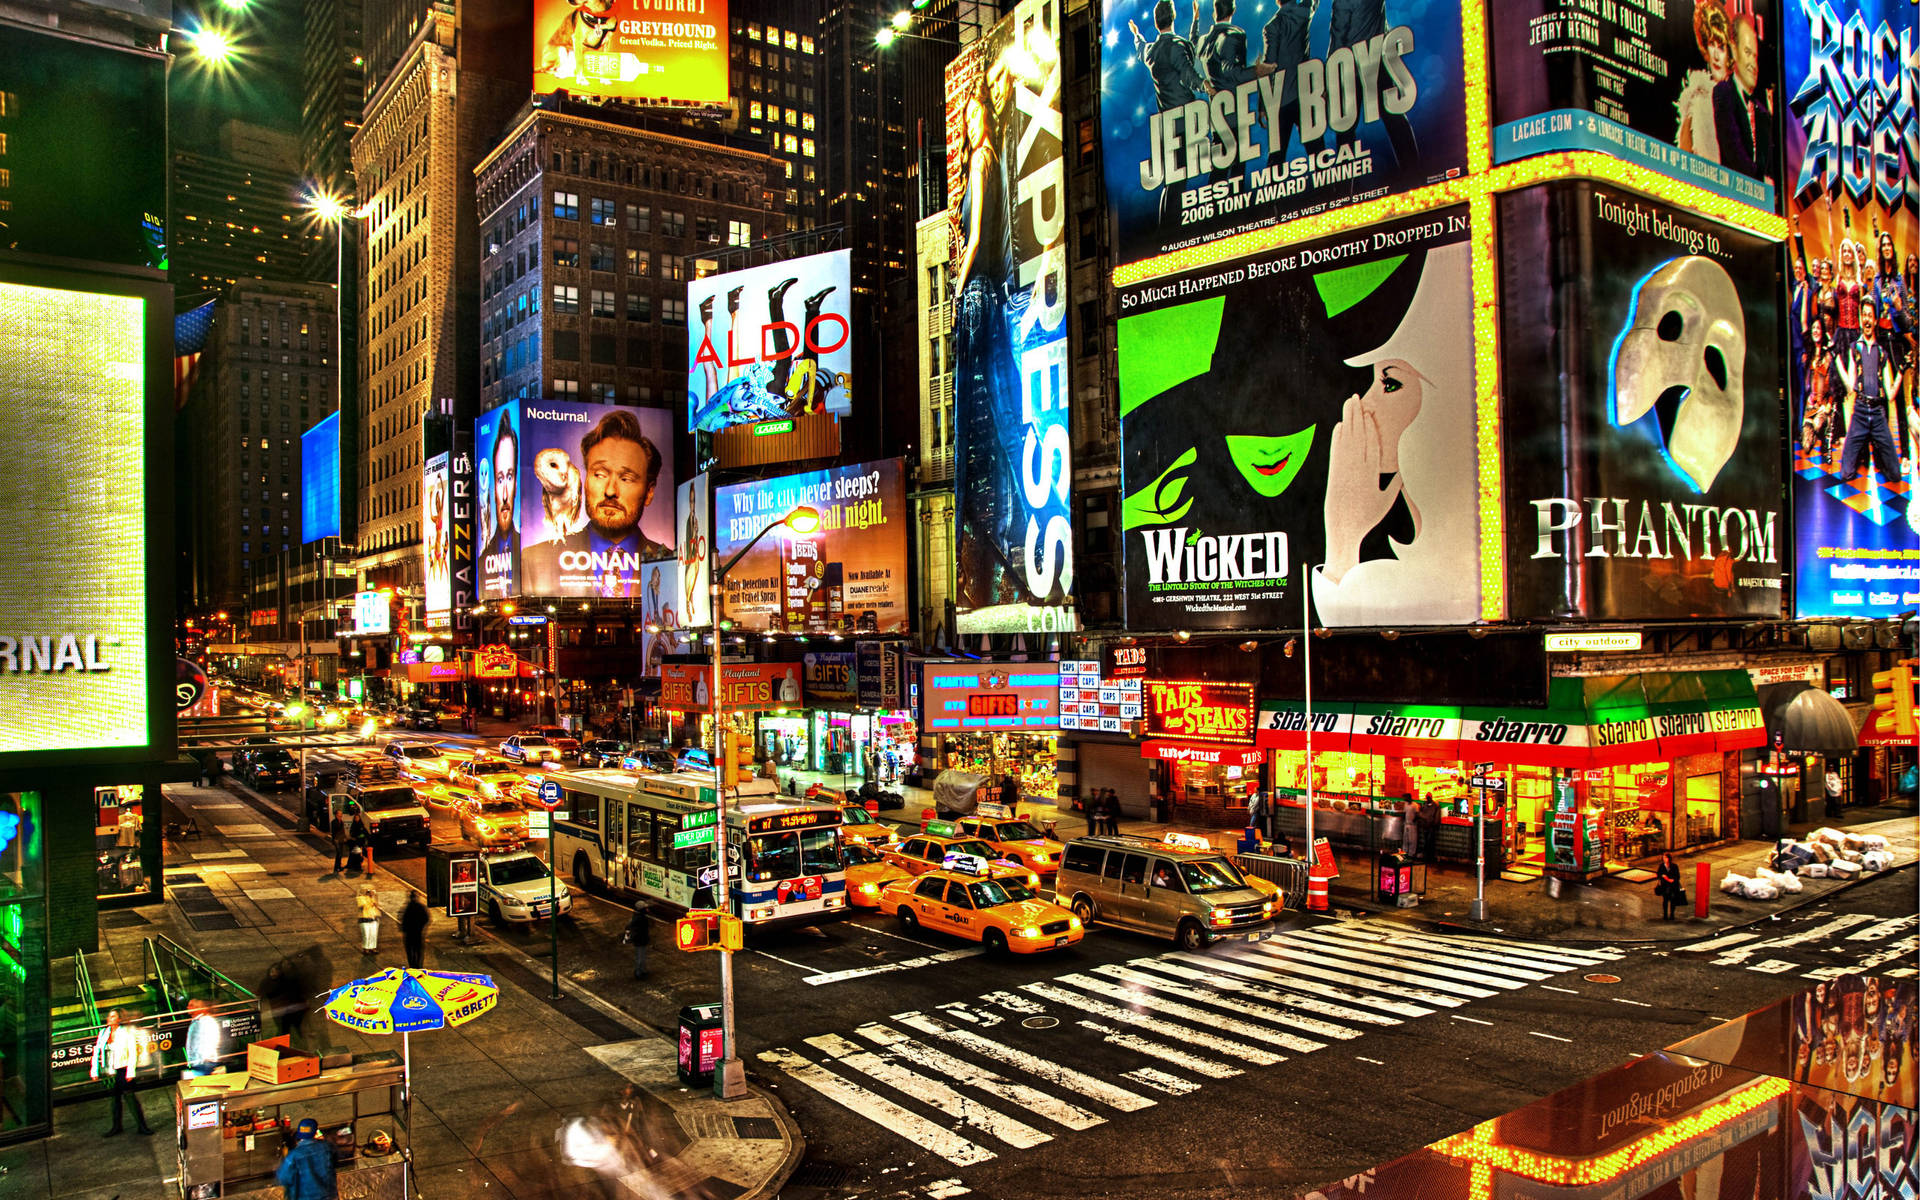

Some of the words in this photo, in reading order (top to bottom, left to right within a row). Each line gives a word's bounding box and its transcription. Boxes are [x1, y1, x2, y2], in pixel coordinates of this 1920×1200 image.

[1529, 12, 1558, 27] MUSIC
[1568, 11, 1591, 24] LYRICS
[1620, 6, 1647, 37] FOLLES
[619, 20, 717, 39] GREYHOUND
[1529, 21, 1562, 46] JERRY
[1568, 21, 1600, 46] HERMAN
[619, 36, 640, 45] Great
[640, 37, 666, 47] Vodka.
[668, 40, 692, 49] Priced
[694, 41, 718, 50] Right.
[1614, 37, 1638, 63] HARVEY
[1638, 48, 1668, 77] FIERSTEIN
[1140, 69, 1286, 191] JERSEY
[1297, 25, 1418, 144] BOYS
[1512, 113, 1573, 143] LACAGE.COM
[1181, 175, 1243, 209] BEST
[1251, 139, 1371, 185] MUSICAL
[1181, 199, 1214, 225] 2006
[1218, 192, 1251, 217] TONY
[1312, 157, 1373, 189] WINNER
[1168, 236, 1201, 252] AUGUST
[1202, 227, 1235, 242] WILSON
[1237, 216, 1279, 233] THEATRE,
[1280, 211, 1299, 222] 245
[1300, 203, 1326, 217] WEST
[1352, 186, 1390, 203] STREET
[1594, 192, 1650, 236] Tonight
[1653, 209, 1704, 254] belongs
[1706, 232, 1733, 259] to...
[1140, 285, 1177, 305] MUCH
[1179, 269, 1245, 296] HAPPENED
[1247, 256, 1297, 280] BEFORE
[1300, 238, 1369, 267] DOROTHY
[1373, 222, 1443, 250] DROPPED
[689, 313, 849, 373] ALDO
[527, 407, 591, 423] Nocturnal.
[757, 423, 790, 433] LAMAR
[732, 493, 755, 514] Why
[757, 489, 775, 510] the
[799, 481, 832, 502] never
[835, 470, 880, 499] sleeps?
[823, 504, 841, 530] all
[845, 499, 887, 530] night.
[1530, 497, 1778, 564] PHANTOM
[559, 551, 640, 571] CONAN
[677, 535, 706, 567] ALDO
[485, 552, 512, 574] CONAN
[742, 578, 769, 590] Detection
[770, 576, 779, 588] Kit
[860, 570, 884, 580] Available
[1148, 582, 1161, 592] THE
[1162, 581, 1189, 591] UNTOLD
[1190, 581, 1210, 591] STORY
[1211, 581, 1220, 590] OF
[1221, 580, 1233, 589] THE
[1234, 579, 1265, 588] WITCHES
[1266, 578, 1275, 587] OF
[1276, 577, 1287, 587] OZ
[729, 593, 740, 603] and
[742, 591, 760, 602] Travel
[760, 591, 776, 602] Spray
[850, 585, 869, 594] DUANE
[1166, 594, 1194, 602] GERSHWIN
[1223, 593, 1233, 601] 222
[1234, 592, 1250, 601] WEST
[1261, 591, 1284, 600] STREET
[1559, 636, 1581, 648] city
[1585, 635, 1630, 646] outdoor
[722, 667, 760, 679] Playland
[813, 663, 850, 683] GIFTS
[1062, 663, 1075, 671] CAPS
[1759, 668, 1779, 676] SPACE
[1082, 677, 1095, 686] CAPS
[663, 682, 693, 702] GIFTS
[1063, 690, 1075, 698] CAPS
[1102, 692, 1116, 701] CAPS
[1151, 684, 1203, 714] TAD'S
[970, 695, 1016, 715] GIFTS
[1082, 705, 1096, 714] CAPS
[1124, 706, 1138, 715] CAPS
[1063, 717, 1076, 726] CAPS
[1103, 720, 1117, 729] CAPS
[1183, 707, 1248, 734] STEAKS
[1269, 708, 1339, 733] sbarro
[1366, 710, 1445, 738] sbarro
[1659, 709, 1705, 737] sbarro
[1716, 706, 1757, 731] sbarro
[1476, 716, 1568, 746] sbarro
[1598, 718, 1647, 747] sbarro
[1190, 750, 1220, 762] STEAKS
[1241, 750, 1262, 764] TAD'S
[690, 815, 697, 827] W
[698, 812, 708, 823] 47
[675, 831, 695, 843] FATHER
[695, 829, 713, 841] DUFFY
[448, 992, 495, 1021] SABRETT
[330, 1009, 389, 1030] SABRETT
[51, 1048, 66, 1060] 49
[68, 1045, 82, 1058] St
